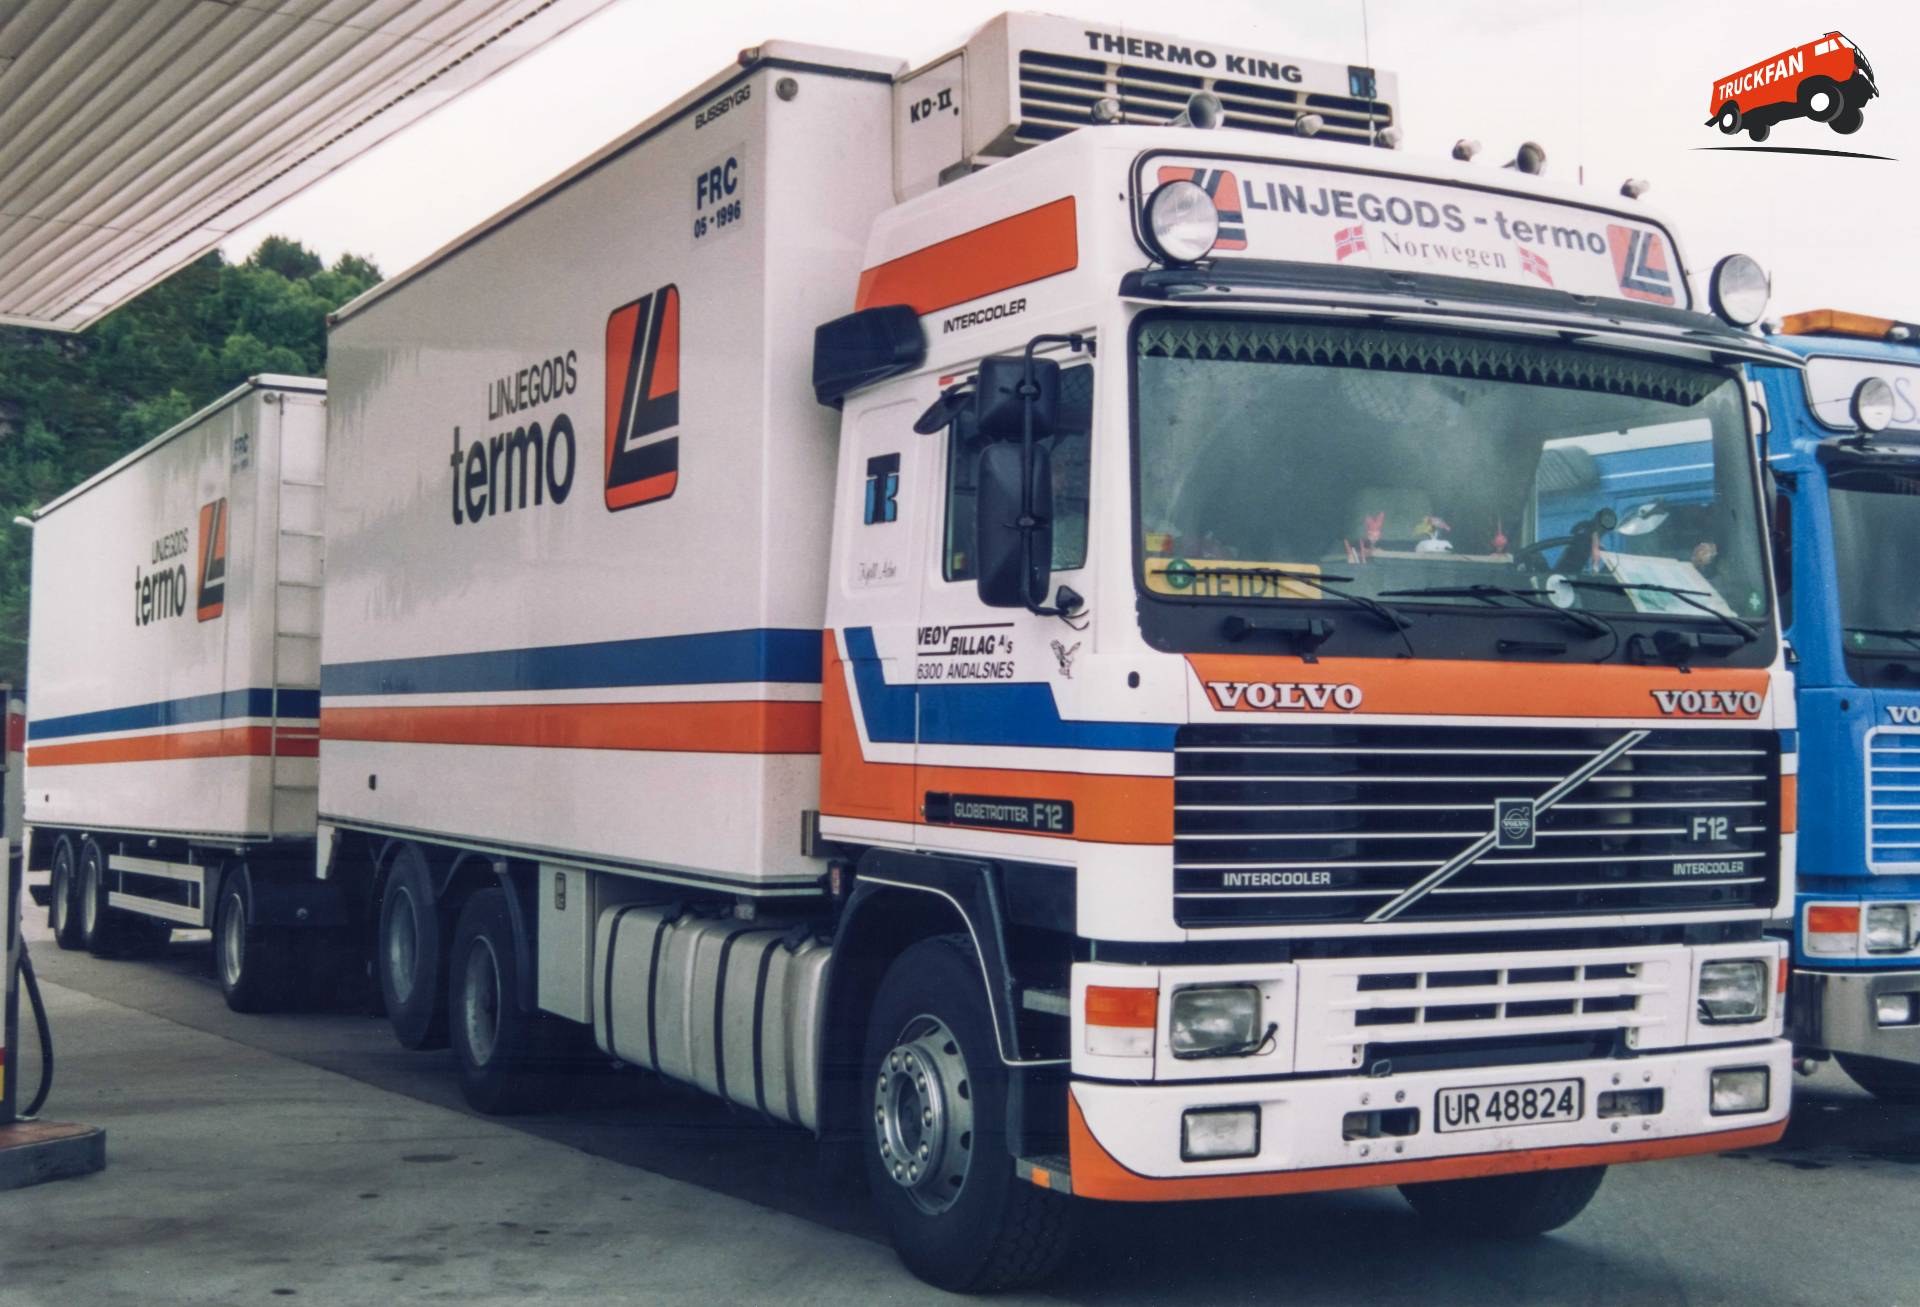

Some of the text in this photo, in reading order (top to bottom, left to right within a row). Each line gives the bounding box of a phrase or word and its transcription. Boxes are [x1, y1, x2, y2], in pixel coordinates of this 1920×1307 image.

[1084, 31, 1303, 83] THERMO KING
[697, 157, 738, 211] FRC
[1244, 180, 1465, 233] LINJEGODS
[1495, 211, 1606, 256] termo
[1382, 231, 1507, 270] Norwegen
[943, 298, 1026, 334] INTERCOOLER
[488, 349, 577, 421] LINJEGODS
[450, 413, 576, 525] termo
[135, 563, 187, 627] termo
[917, 626, 951, 646] VEØY
[949, 635, 996, 656] BILLAG
[917, 662, 943, 679] 6300
[1207, 681, 1363, 710] VOLVO
[1652, 690, 1762, 715] VOLVO
[953, 802, 1064, 830] GLOBETROTTER F12
[1692, 816, 1729, 841] F12
[1223, 871, 1332, 887] INTERCOOLER
[1673, 861, 1744, 876] INTERCOOLER
[1444, 1086, 1575, 1126] UR 48824
